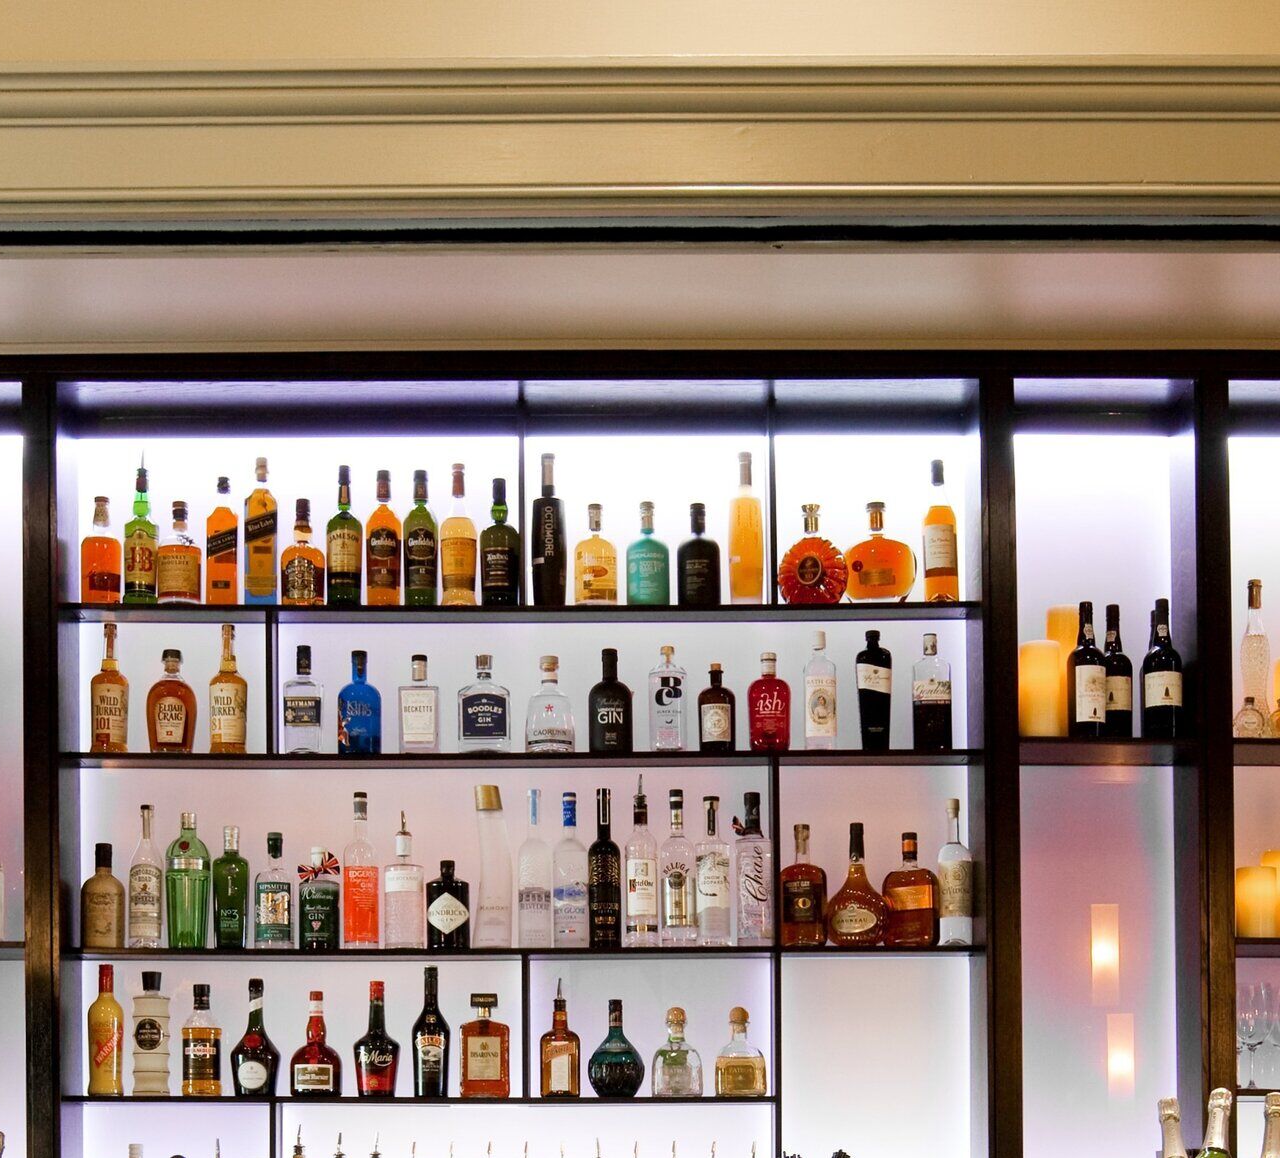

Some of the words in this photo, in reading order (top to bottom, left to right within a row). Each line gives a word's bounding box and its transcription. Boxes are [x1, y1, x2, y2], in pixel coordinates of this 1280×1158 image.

[543, 505, 555, 557] OCTOMORE
[328, 532, 360, 543] JAMESON
[407, 537, 435, 547] Glenfiddich
[99, 695, 119, 706] WILD
[213, 695, 232, 706] WILD
[95, 705, 123, 717] TURKEY
[158, 712, 183, 721] CRAIG
[211, 705, 237, 717] TURKEY
[96, 717, 110, 730] 101
[597, 712, 624, 724] GIN
[663, 862, 690, 875] BELUGA
[744, 846, 769, 906] Chase
